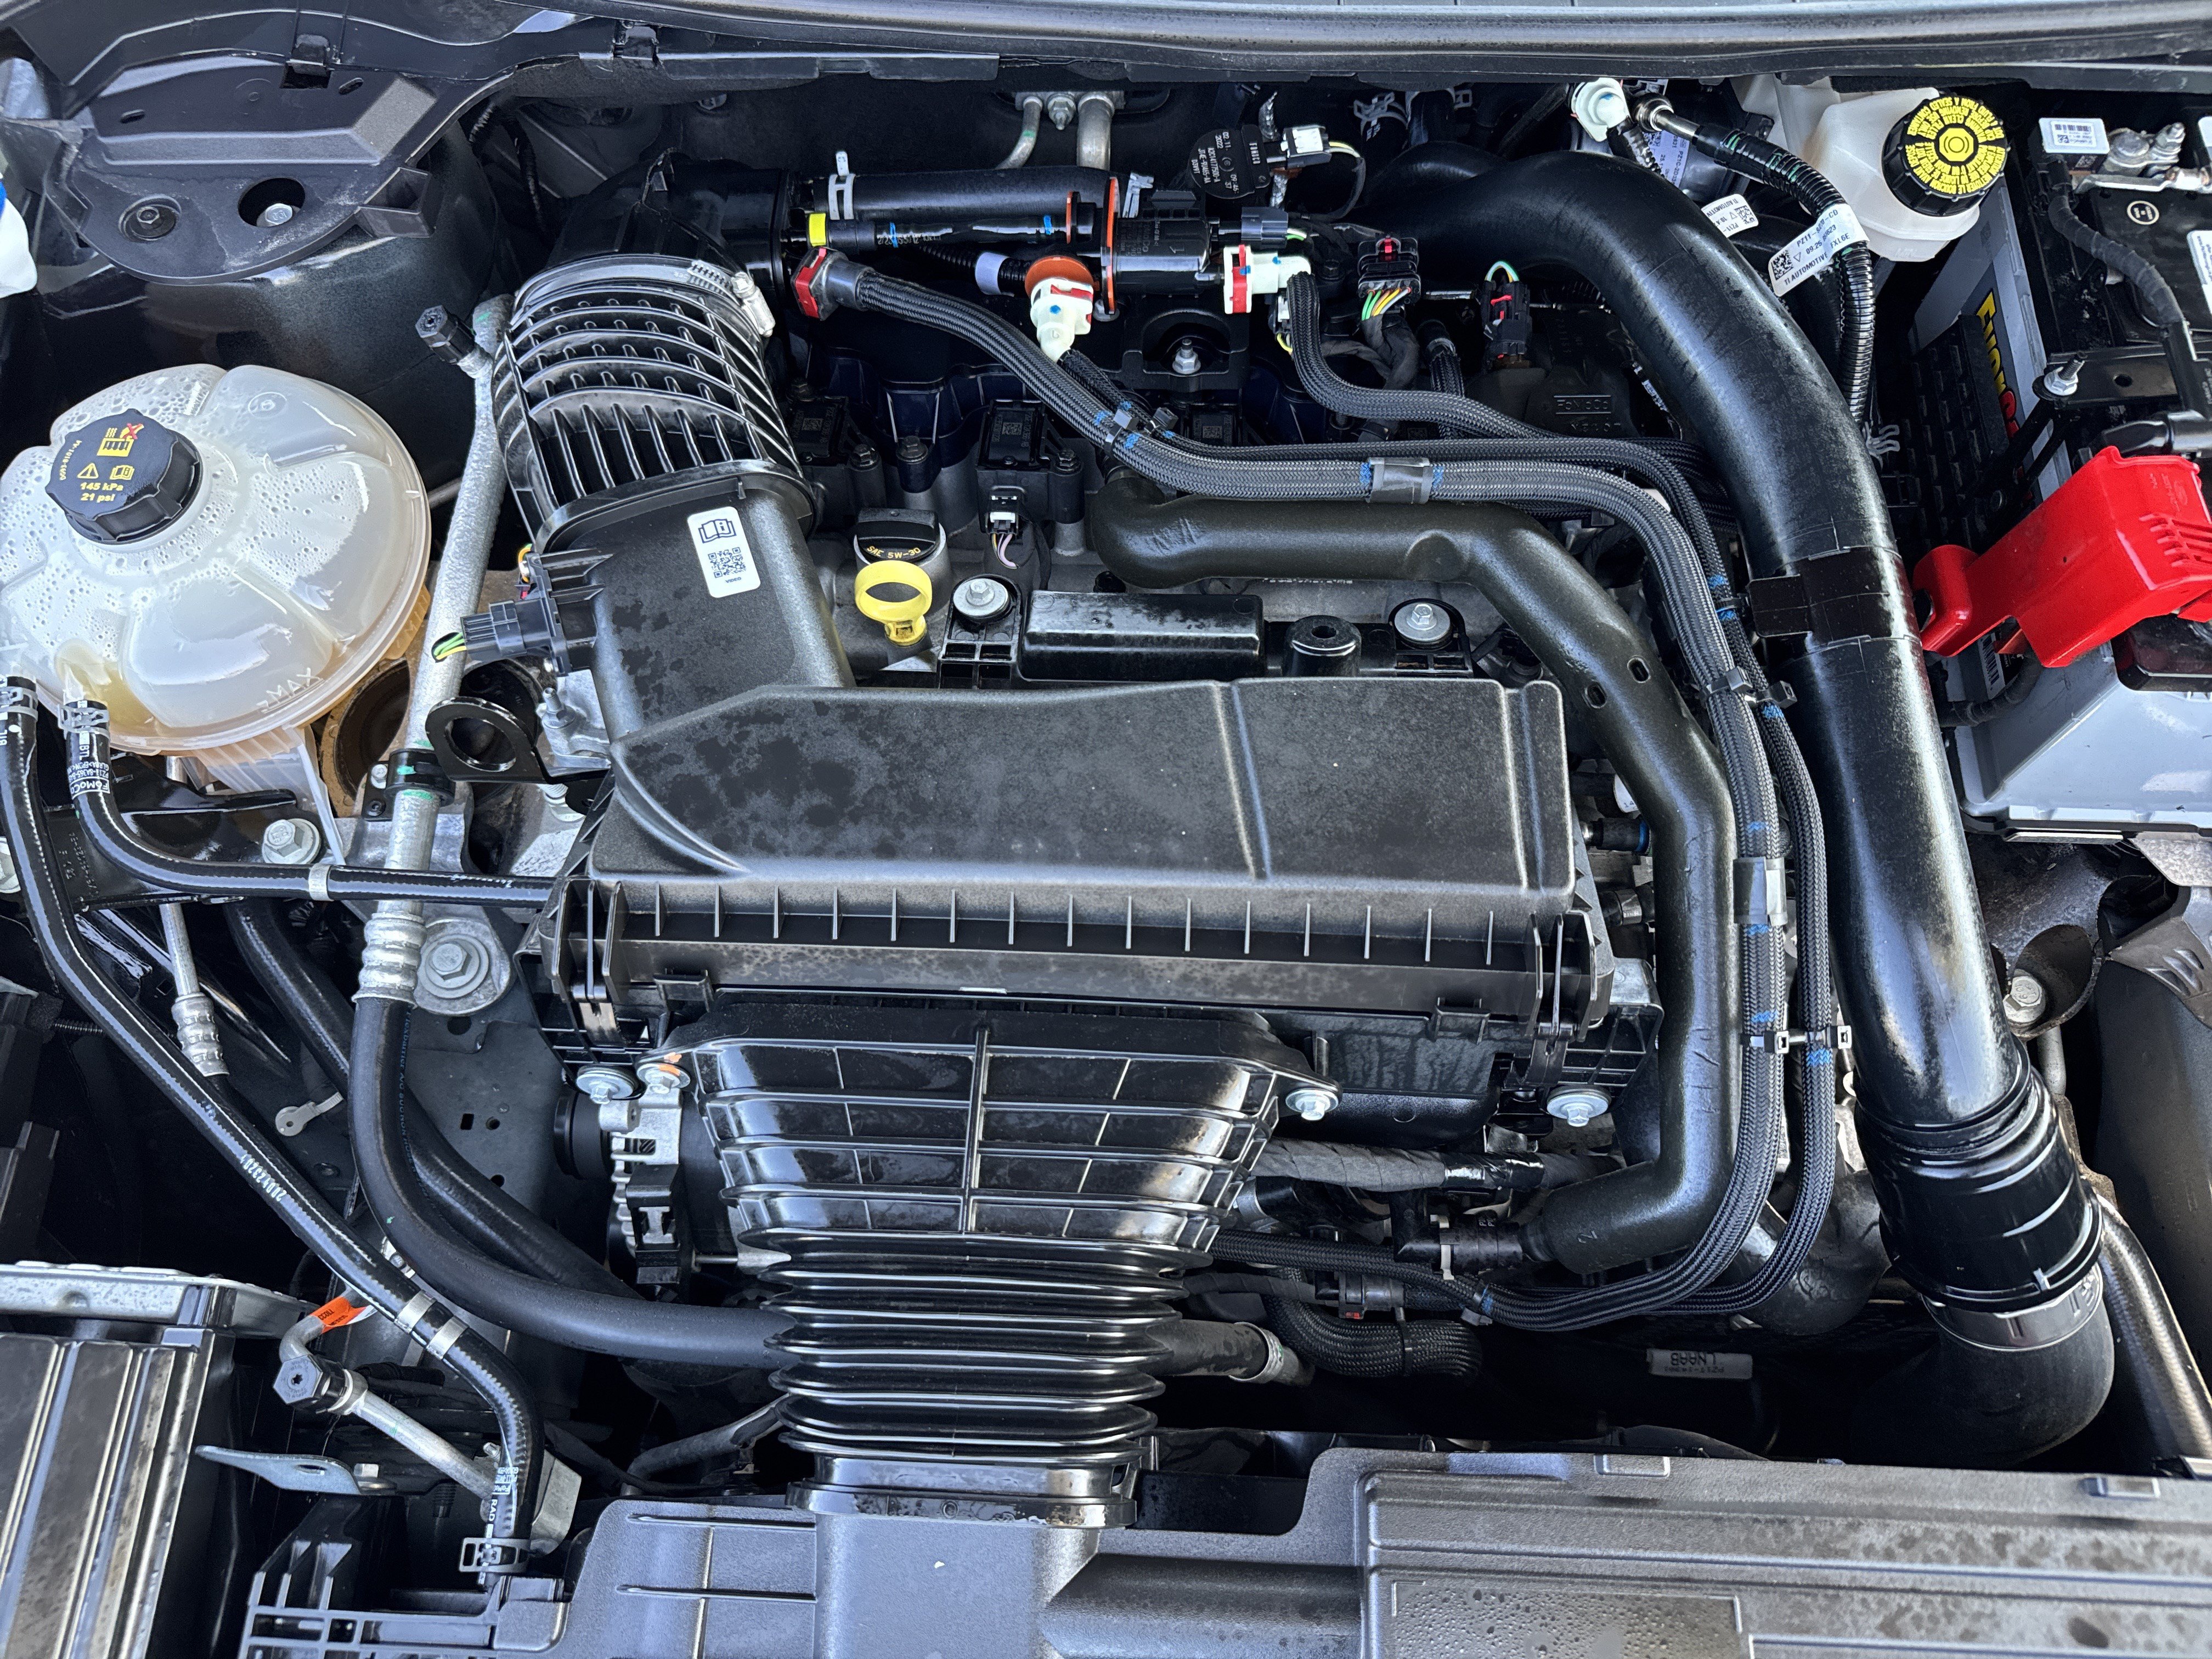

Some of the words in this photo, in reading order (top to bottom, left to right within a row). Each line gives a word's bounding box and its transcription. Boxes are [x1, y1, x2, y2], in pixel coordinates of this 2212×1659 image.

[1929, 97, 1953, 110] SEALED
[1954, 97, 1959, 105] A
[1961, 98, 1979, 110] FROM
[1926, 111, 1940, 123] USE
[1939, 106, 1969, 117] REMOVING
[1978, 106, 1995, 123] FLUID
[1907, 106, 1931, 136] CONTAINER
[1943, 115, 1964, 125] CLEAN
[1970, 110, 1990, 129] BEFORE
[1917, 121, 1931, 137] ONLY
[1984, 129, 1996, 140] CAP
[1215, 135, 1223, 149] 2022
[1989, 146, 2005, 176] ATTENTION
[1914, 168, 1933, 183] AVANT
[1929, 179, 1956, 194] BOUCHON
[1958, 185, 1966, 194] LE
[1967, 173, 1993, 193] NETTOYER
[1806, 241, 1822, 254] 09:25
[1791, 252, 1827, 281] AUTOMOTIVE
[80, 482, 101, 490] 145
[102, 482, 124, 491] kPa
[81, 493, 95, 501] 21
[97, 494, 116, 503] psi
[867, 545, 884, 557] SAE
[887, 547, 921, 558] 5W-30
[266, 667, 324, 703] MAX
[79, 744, 90, 761] BTL
[70, 780, 109, 794] FoMoCo
[489, 1499, 498, 1522] RAD
